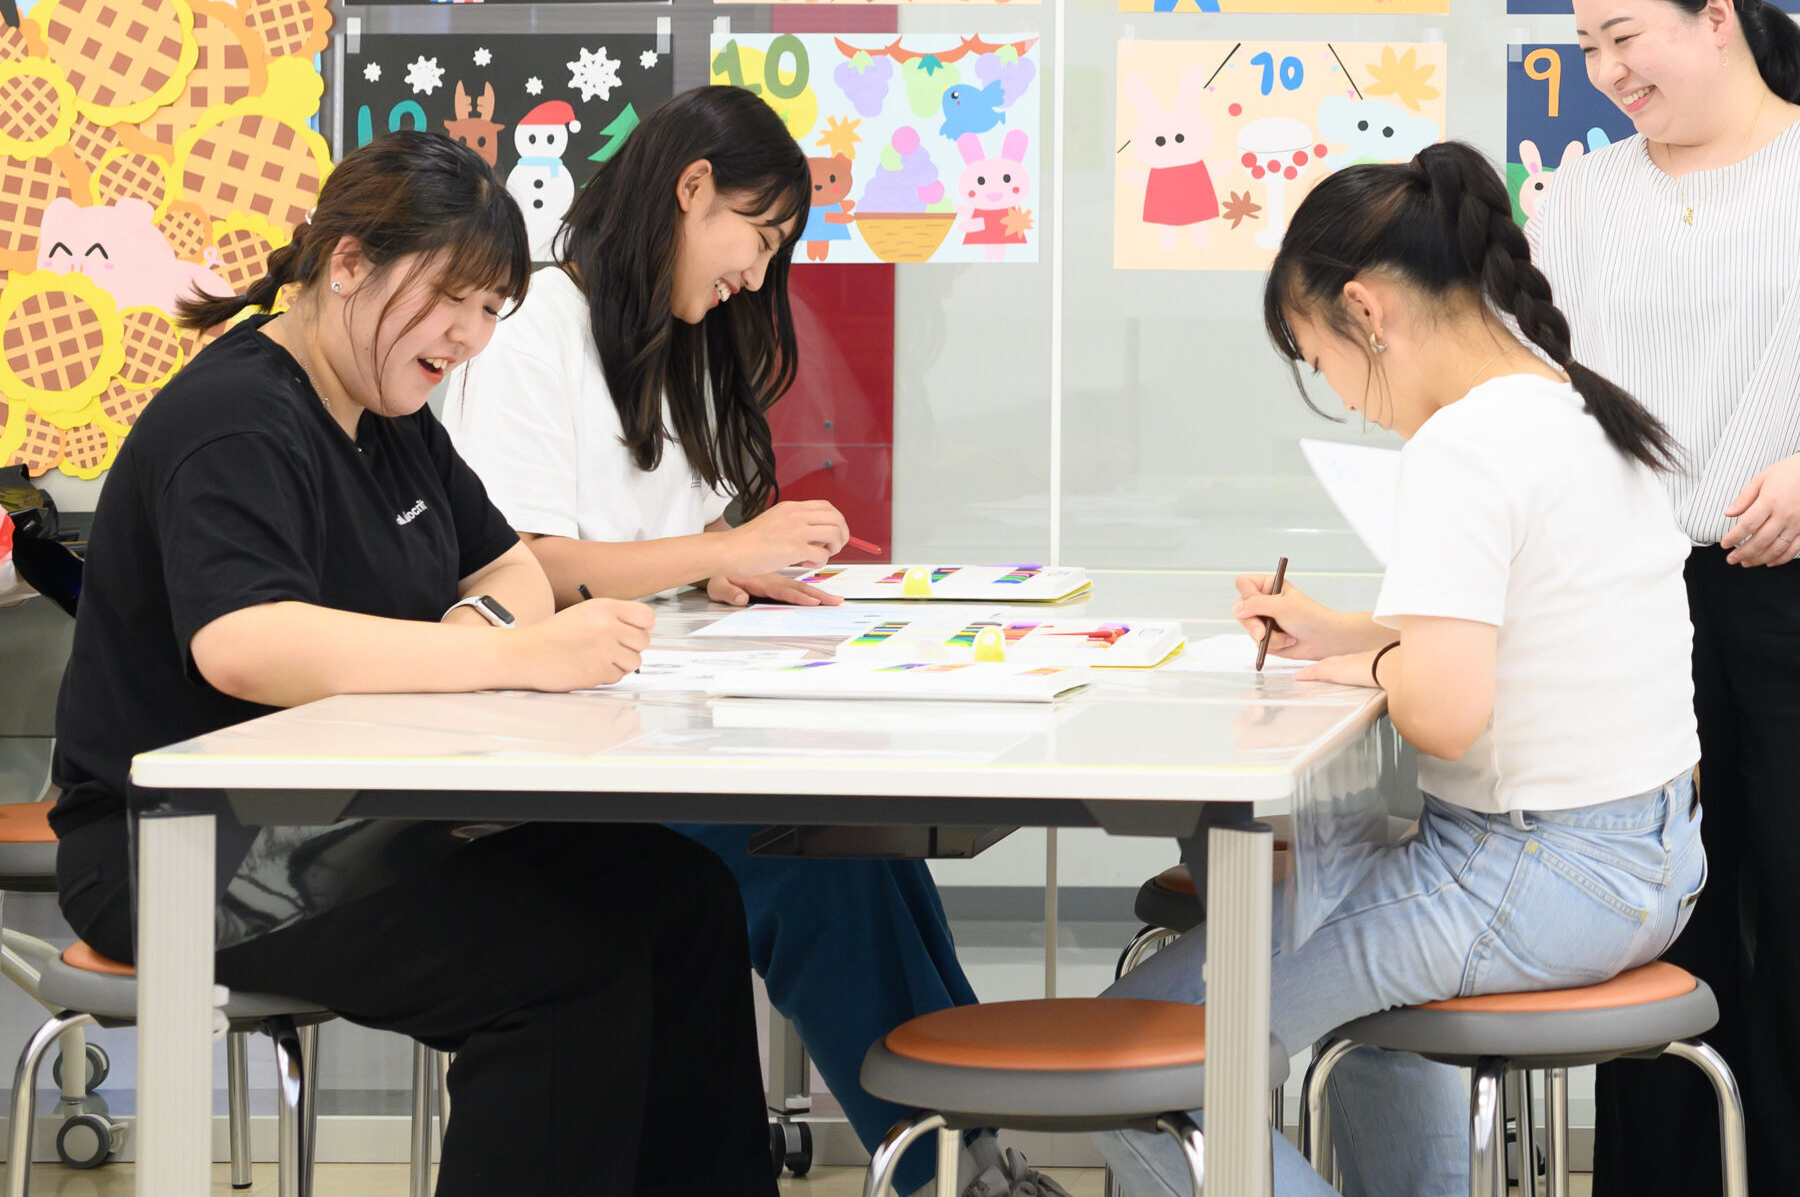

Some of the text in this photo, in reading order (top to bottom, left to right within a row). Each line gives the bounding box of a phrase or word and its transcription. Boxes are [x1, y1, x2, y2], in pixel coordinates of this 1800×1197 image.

[712, 34, 810, 100] 10
[1250, 51, 1304, 95] 10
[1524, 48, 1563, 117] 9
